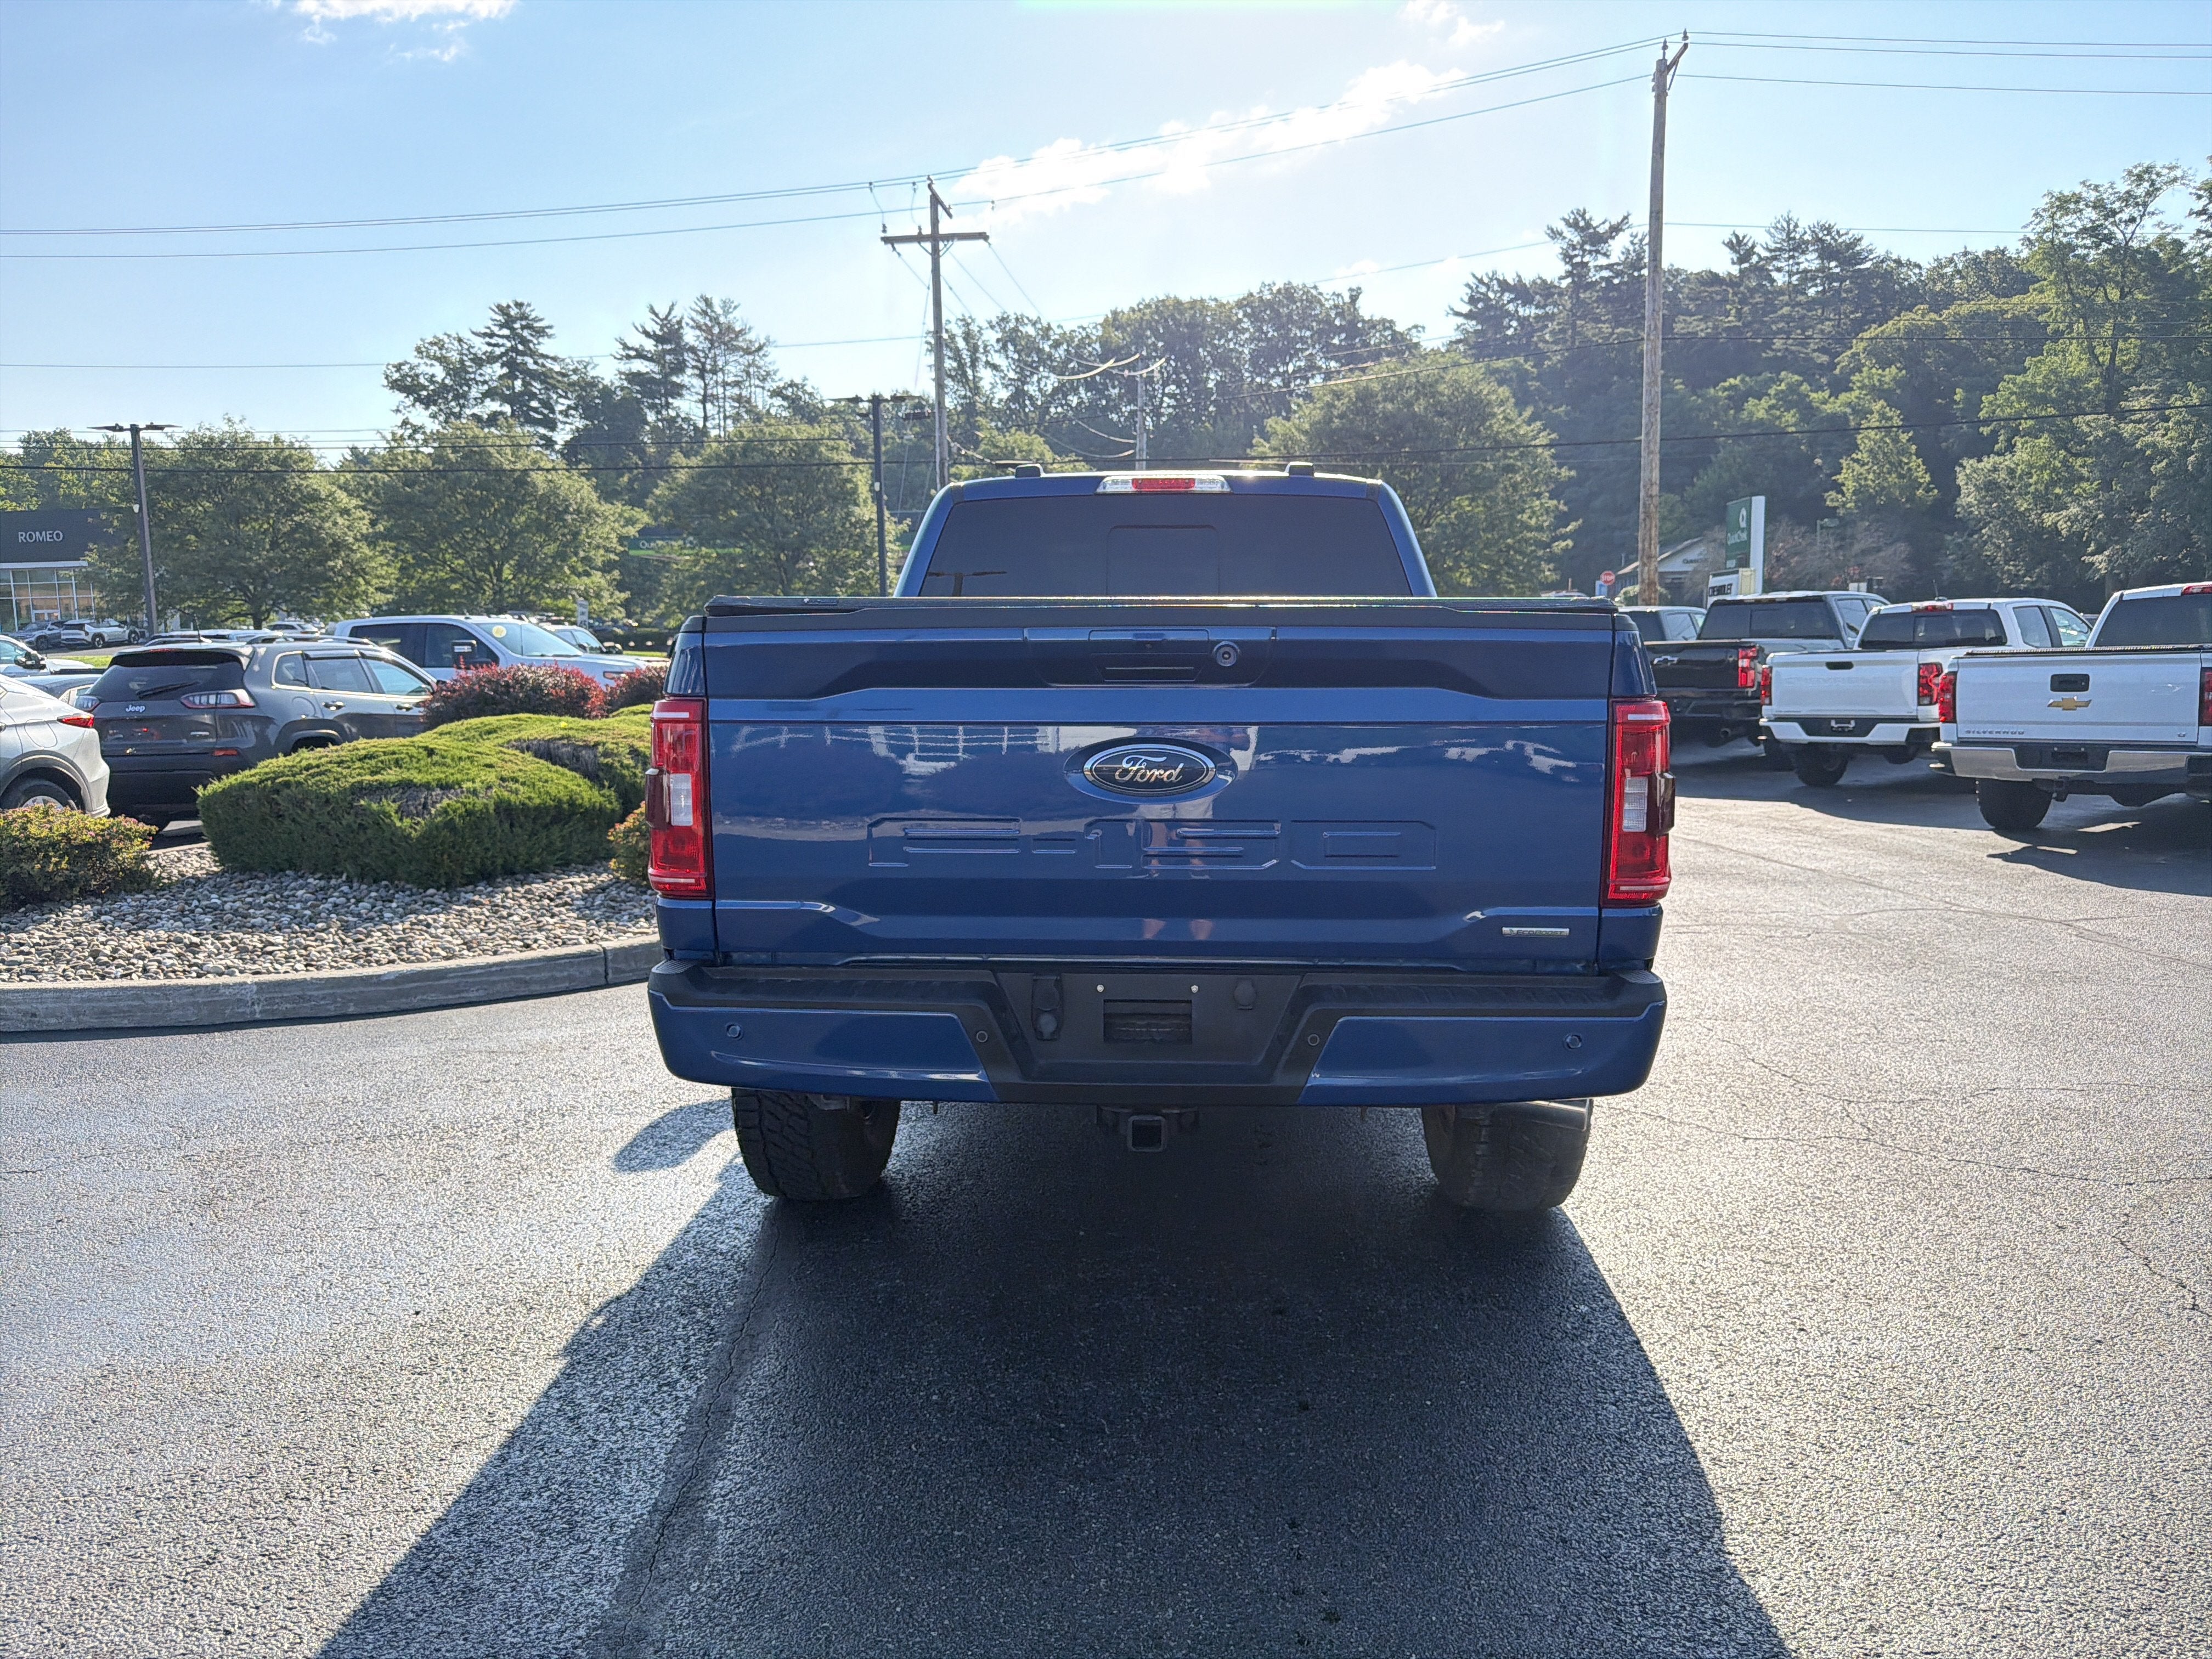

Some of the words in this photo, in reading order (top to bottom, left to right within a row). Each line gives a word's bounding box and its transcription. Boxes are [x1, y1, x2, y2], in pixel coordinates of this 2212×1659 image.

[18, 531, 63, 543] ROMEO
[1115, 755, 1184, 783] Ford
[868, 817, 1436, 870] F-150
